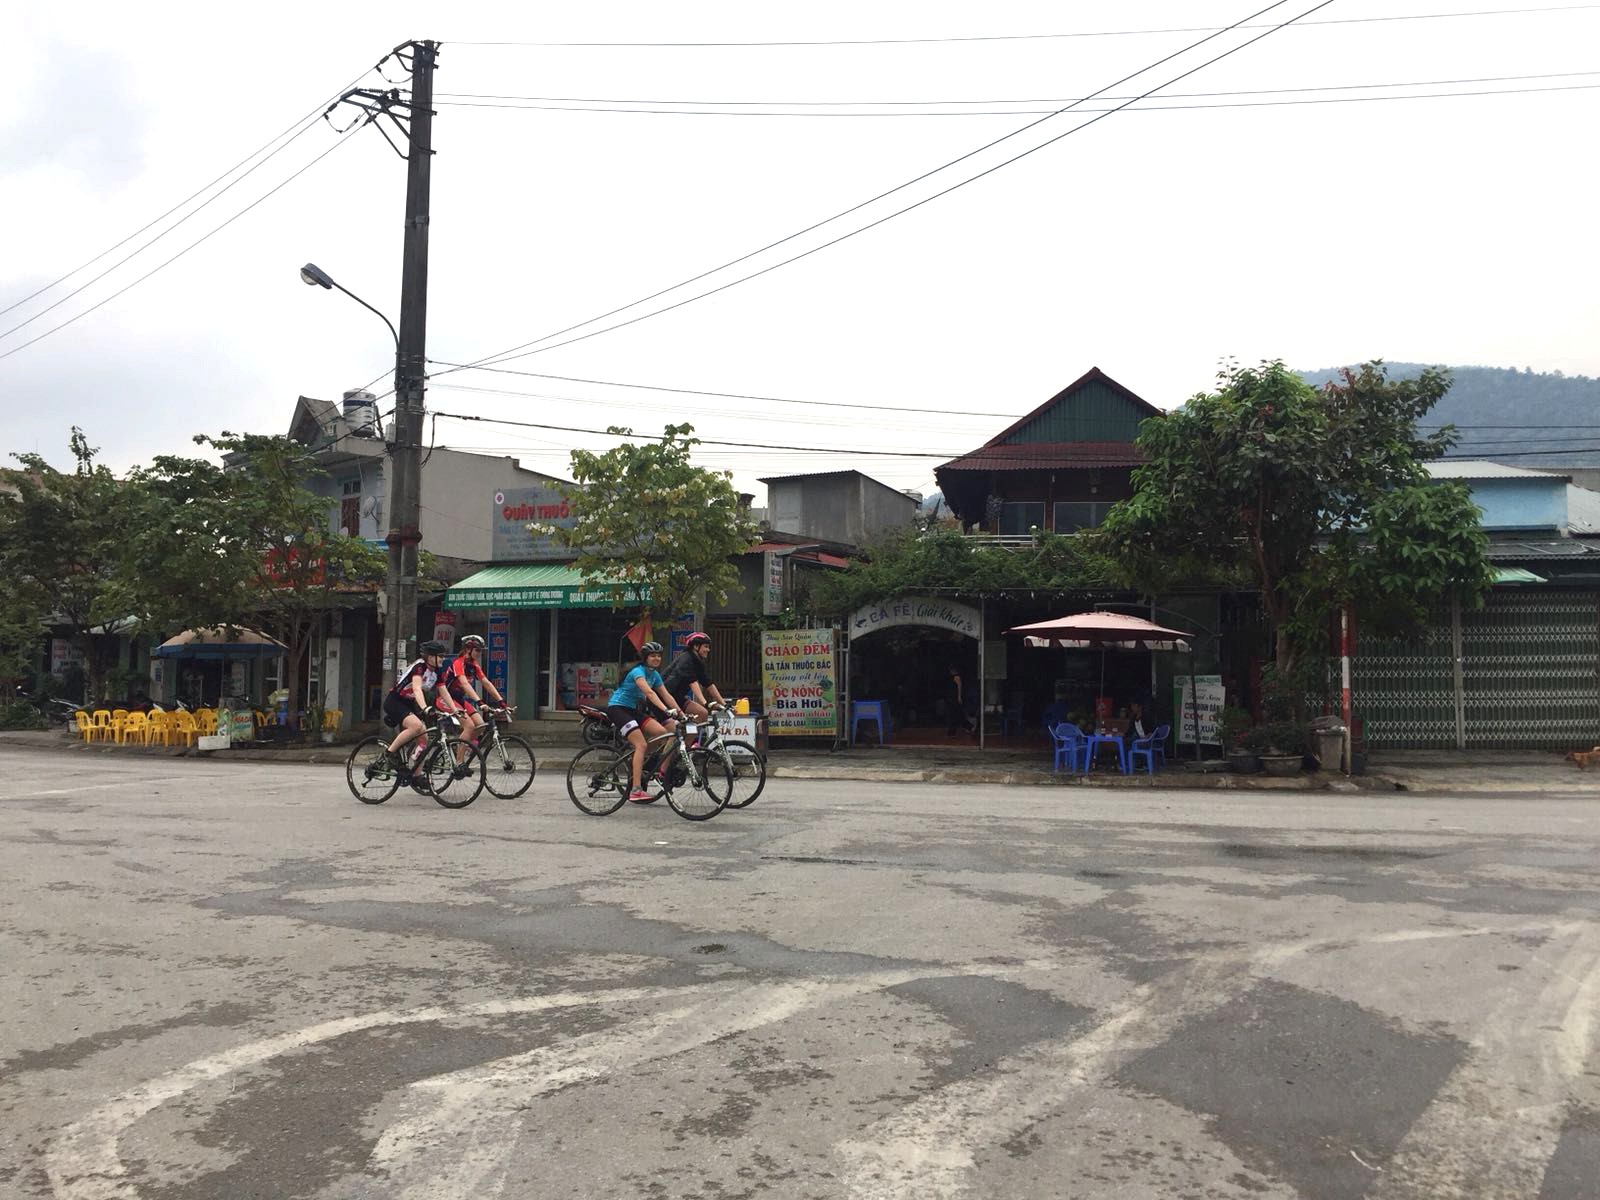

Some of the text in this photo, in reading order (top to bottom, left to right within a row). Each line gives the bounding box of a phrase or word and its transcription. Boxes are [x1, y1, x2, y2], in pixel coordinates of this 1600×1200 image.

[803, 641, 830, 656] ĐÊM
[776, 699, 823, 709] Bia Hơi
